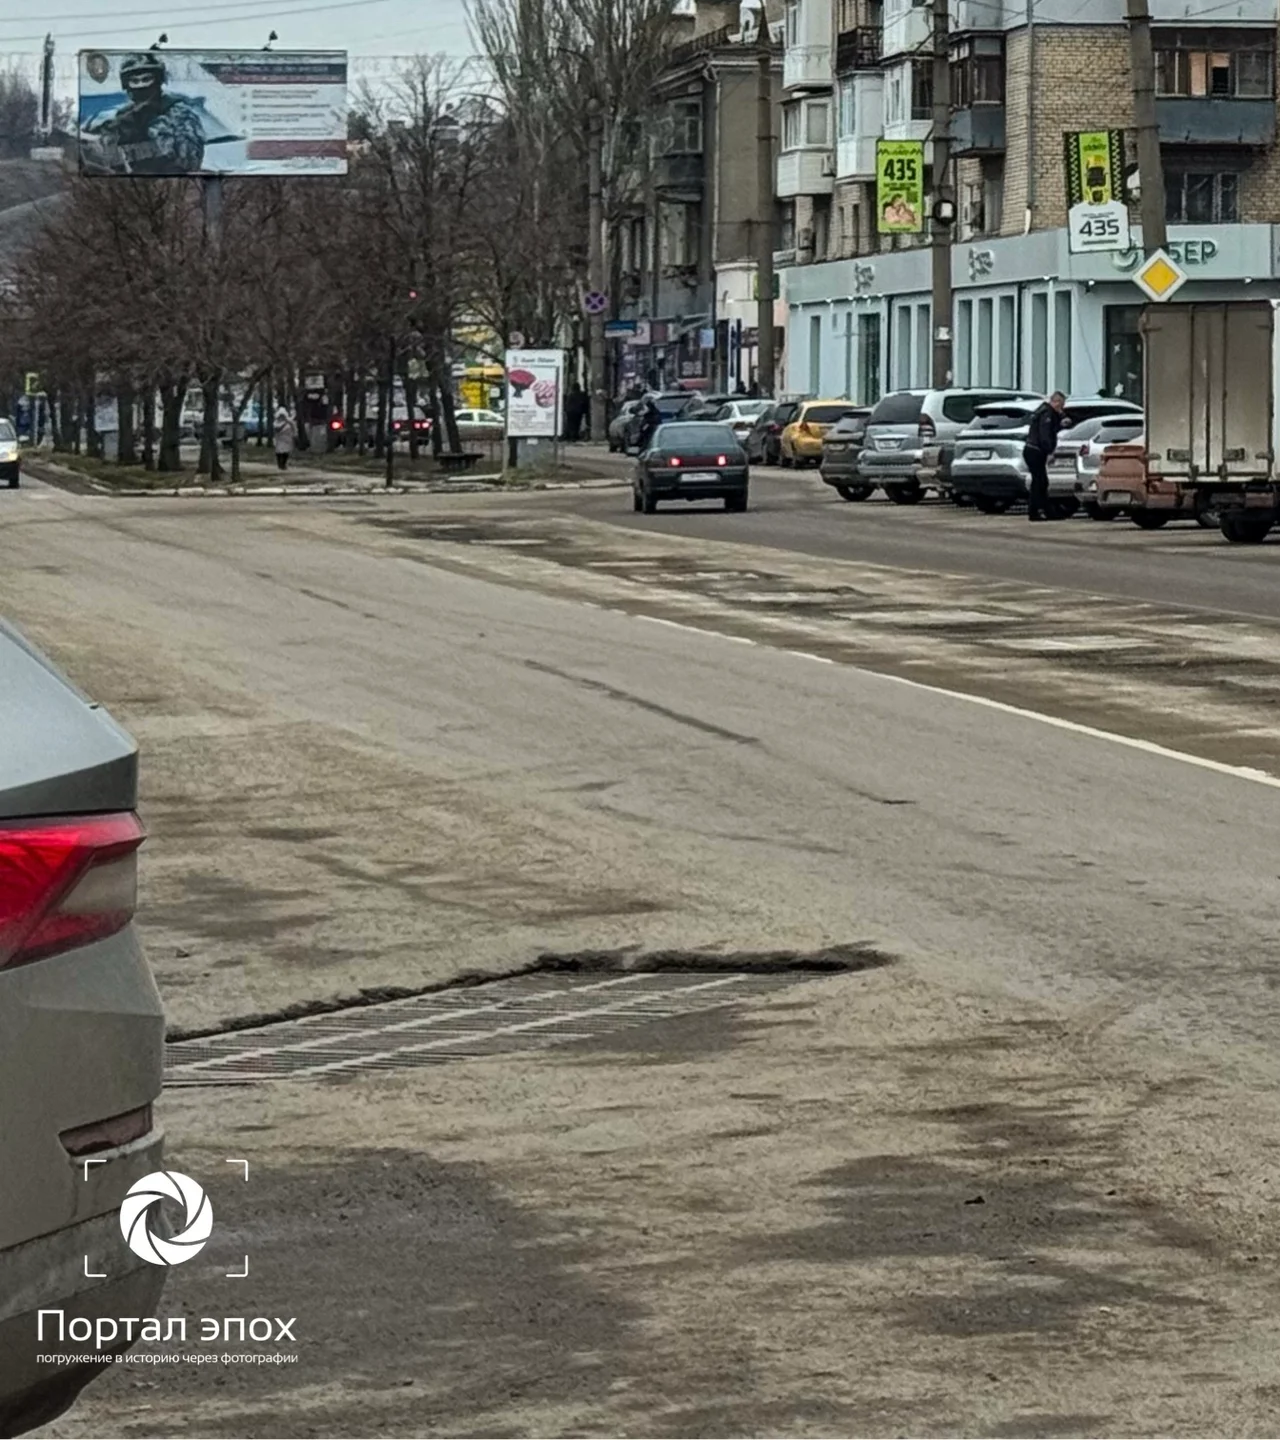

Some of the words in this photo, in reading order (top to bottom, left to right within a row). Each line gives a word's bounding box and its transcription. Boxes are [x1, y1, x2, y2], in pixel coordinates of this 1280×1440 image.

[883, 158, 917, 181] 435
[1079, 219, 1120, 237] 435
[1168, 240, 1217, 265] БЕР
